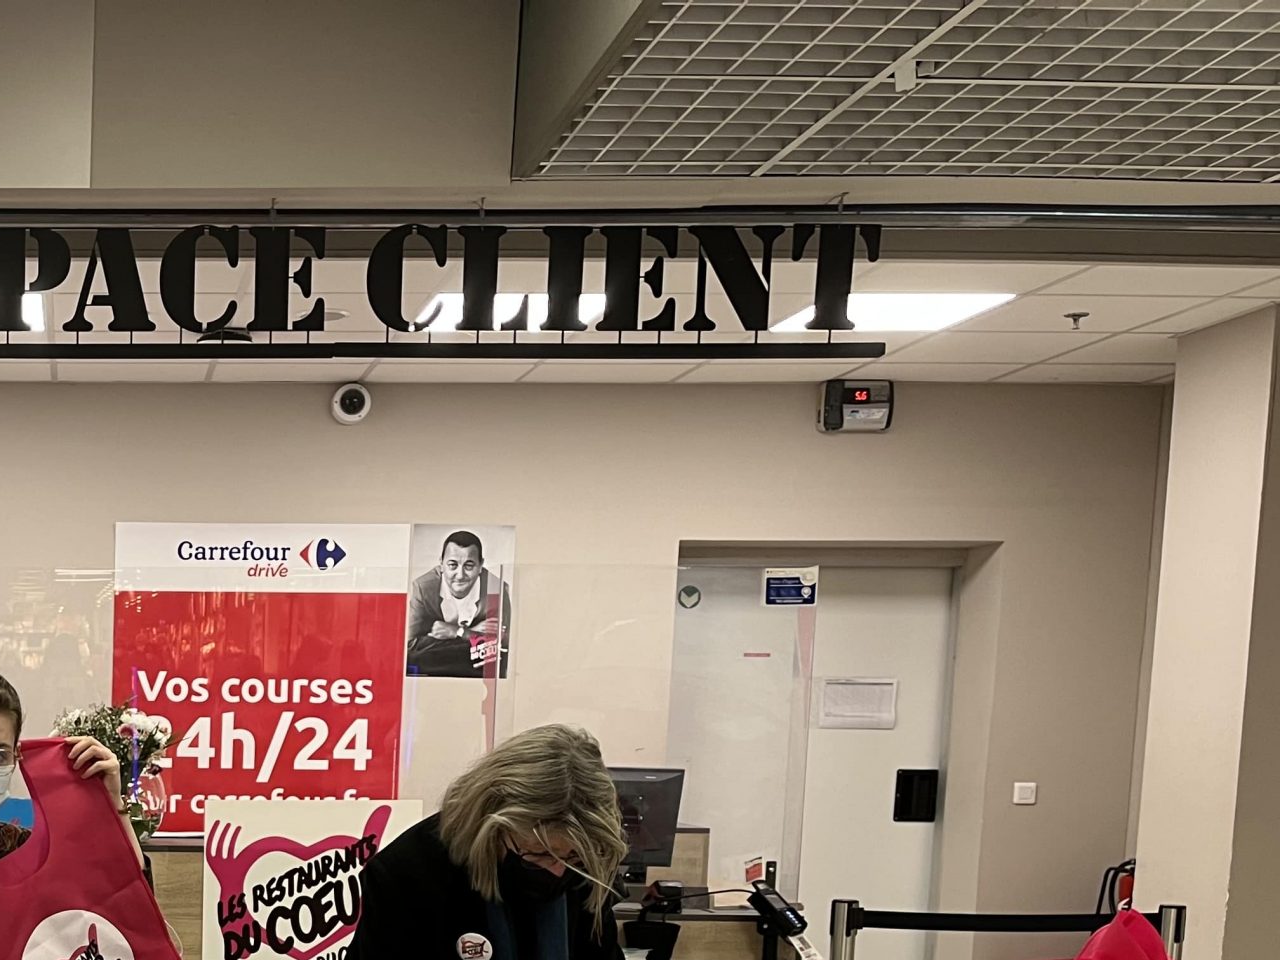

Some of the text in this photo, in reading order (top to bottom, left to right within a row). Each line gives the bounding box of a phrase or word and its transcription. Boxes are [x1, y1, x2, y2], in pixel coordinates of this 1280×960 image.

[366, 224, 881, 333] CLIENT
[178, 540, 290, 561] Carrefour
[247, 561, 288, 578] drive
[138, 670, 373, 704] Vos courses
[218, 834, 378, 927] LES RESTAURANTS
[266, 875, 361, 954] COEU
